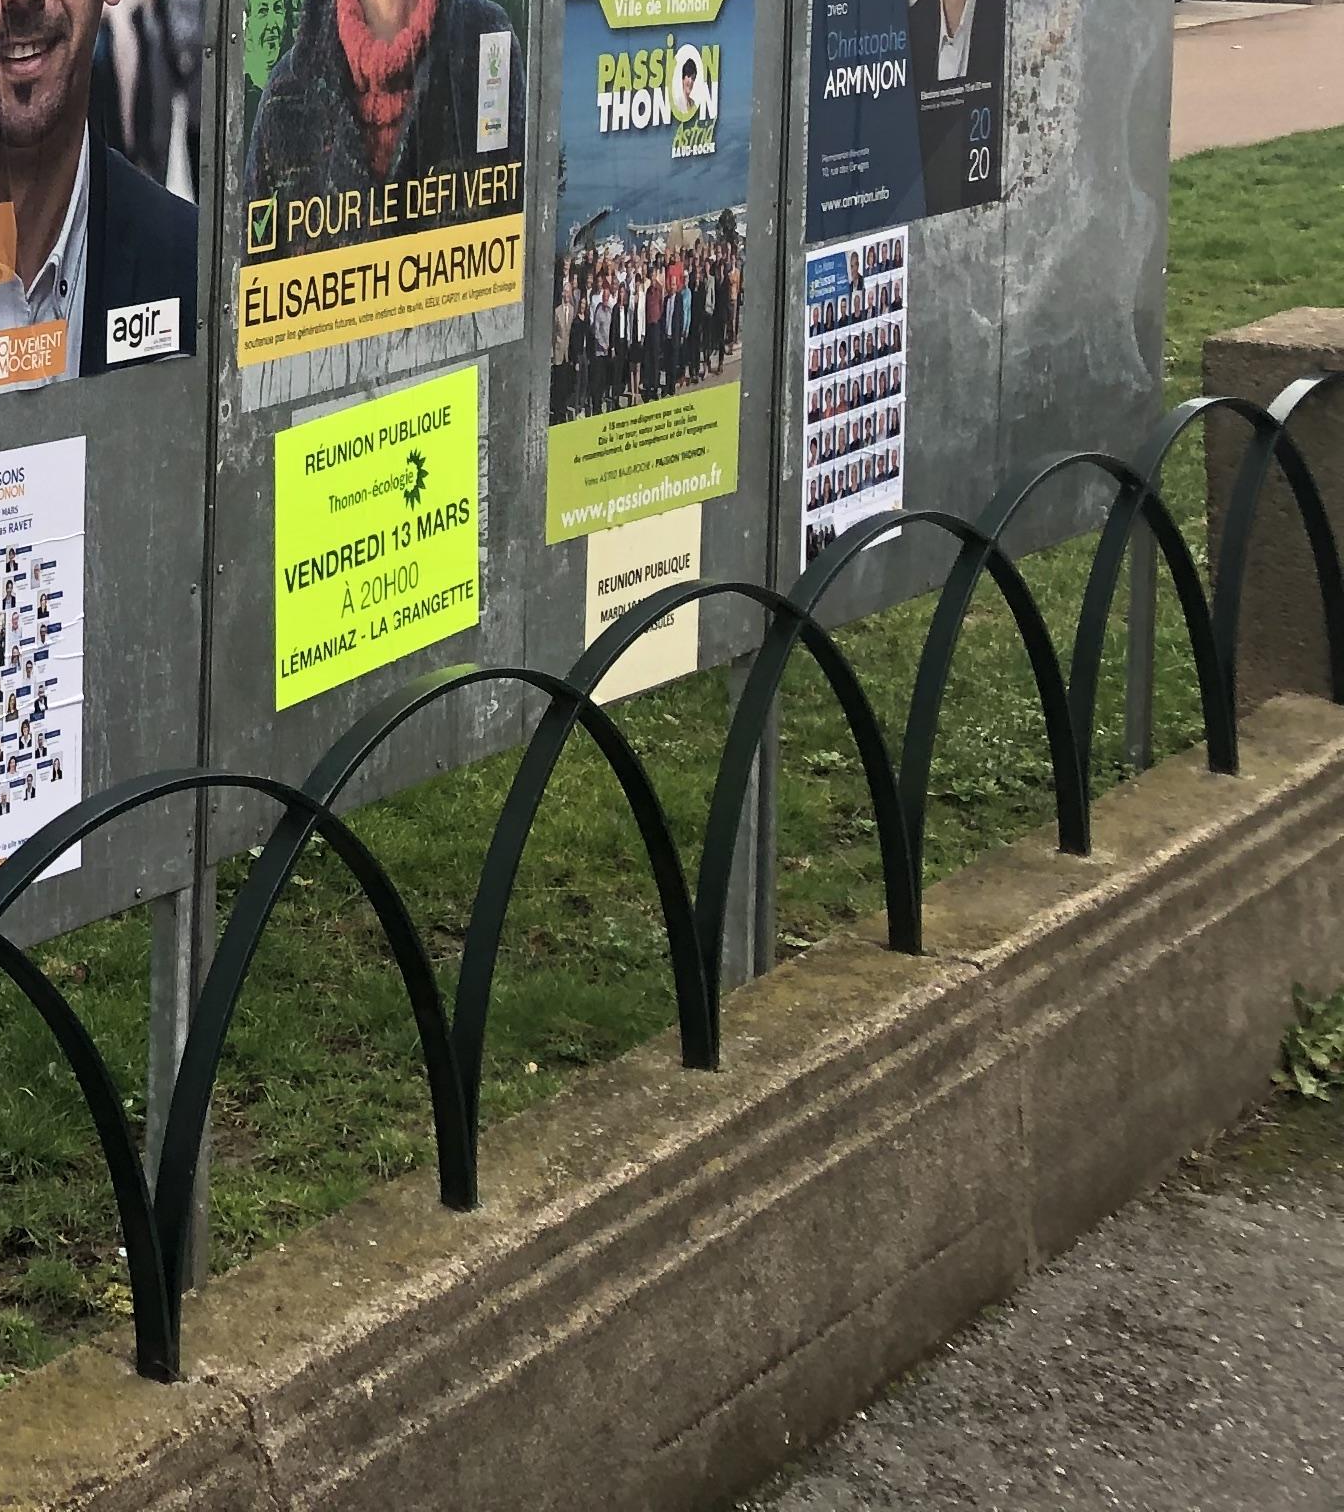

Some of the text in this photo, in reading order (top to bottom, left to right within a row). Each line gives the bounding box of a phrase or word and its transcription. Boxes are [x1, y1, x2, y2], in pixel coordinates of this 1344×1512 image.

[827, 2, 848, 17] avec
[598, 33, 720, 96] PASSION
[826, 24, 906, 61] Christophe
[824, 58, 906, 99] ARMNJON
[597, 80, 719, 133] THONON
[970, 107, 991, 142] 20
[673, 119, 715, 146] Astrid
[968, 147, 990, 182] 20
[288, 162, 521, 242] POUR LE DÉFI VERT
[245, 260, 389, 327] ÉLISABETH
[398, 235, 520, 292] CHARMOT
[306, 405, 451, 476] RÉUNION PUBLIQUE
[329, 469, 414, 514] Thonon-écologie
[561, 462, 722, 528] www.passionthonon.fr
[9, 519, 32, 533] RAVET
[284, 497, 470, 594] VENDREDI 13 MARS
[361, 560, 419, 610] 20H00
[598, 553, 690, 596] REUNION PUBLIQUE
[281, 579, 474, 679] LÉMANIAZ LA GRANGETTE
[600, 602, 625, 623] MARDI
